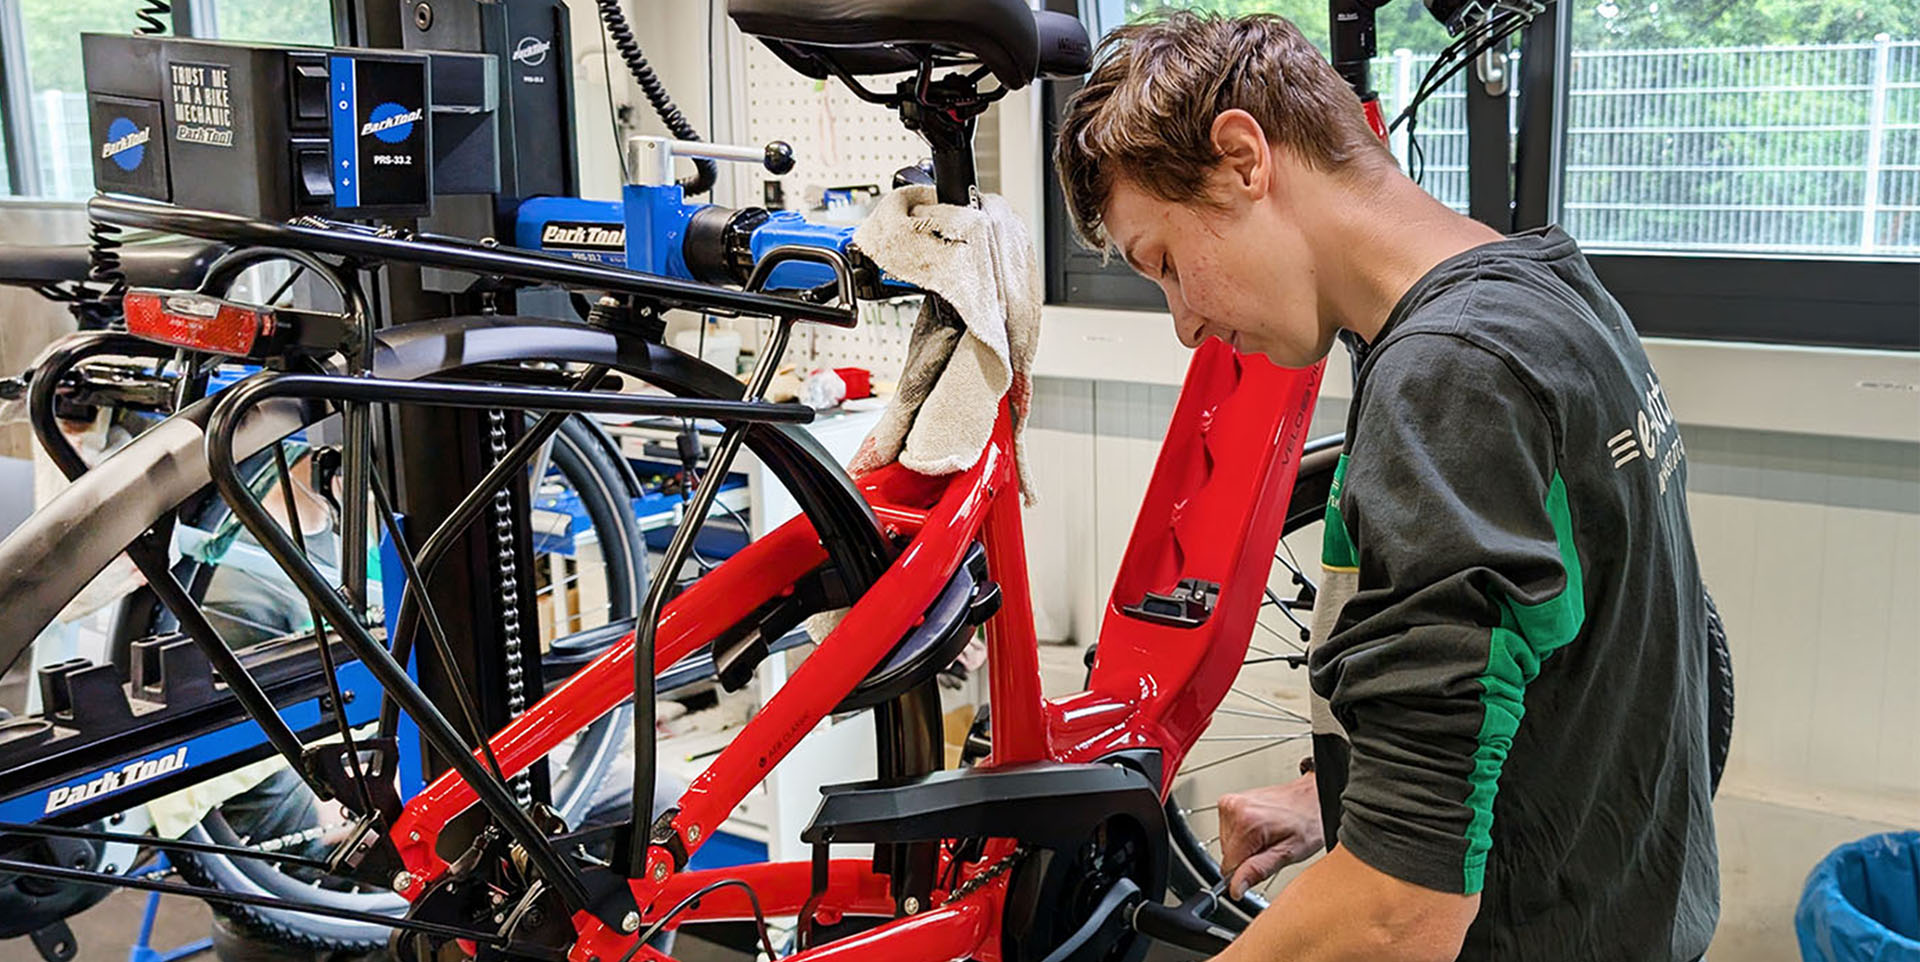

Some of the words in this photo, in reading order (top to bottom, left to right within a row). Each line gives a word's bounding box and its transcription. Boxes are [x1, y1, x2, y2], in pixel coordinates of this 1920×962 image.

[171, 65, 204, 86] TRUST
[211, 69, 228, 88] ME
[173, 84, 191, 103] I'M
[194, 87, 202, 104] A
[204, 88, 230, 108] BIKE
[175, 103, 231, 127] MECHANIC
